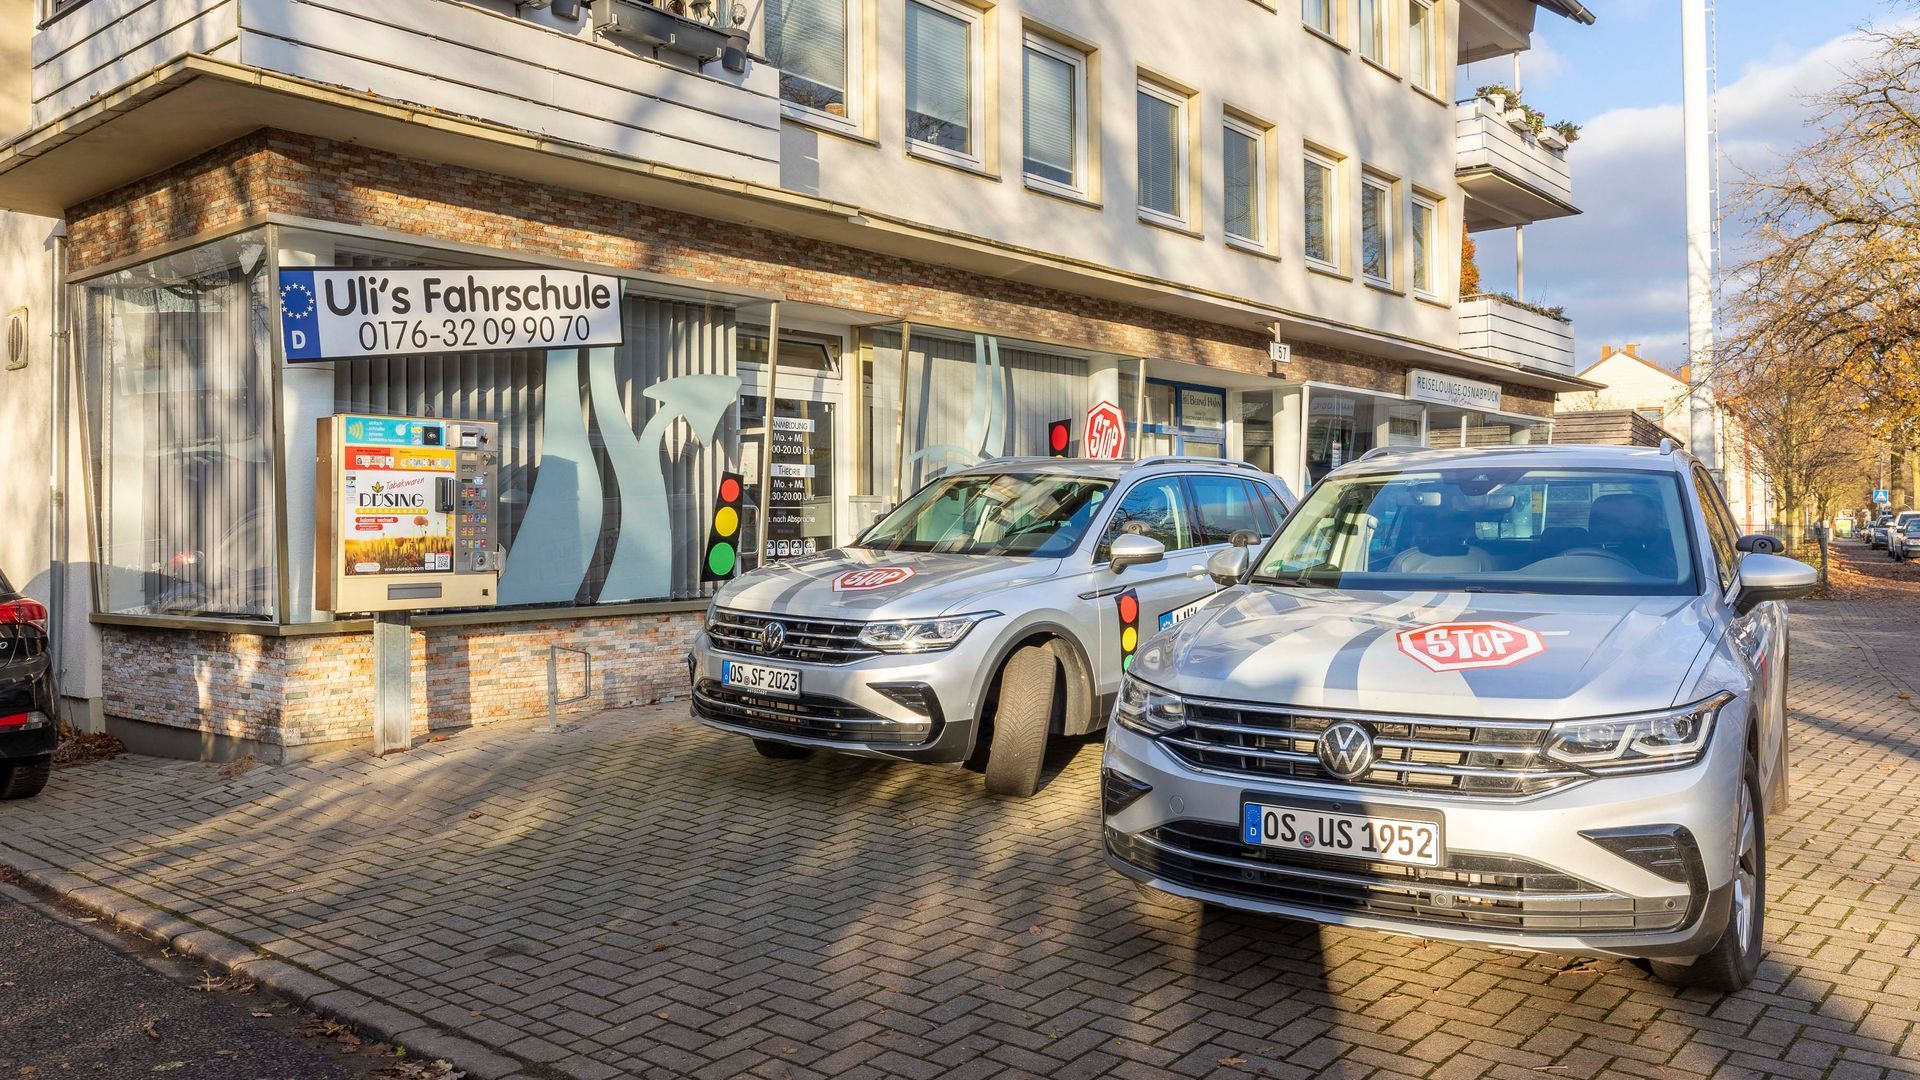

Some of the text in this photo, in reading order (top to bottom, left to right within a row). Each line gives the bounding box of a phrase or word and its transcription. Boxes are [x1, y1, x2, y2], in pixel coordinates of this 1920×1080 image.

[324, 274, 611, 316] Uli's Fahrschule
[292, 330, 306, 350] D
[1278, 346, 1286, 360] 57
[1416, 376, 1461, 396] REISELOUNGE
[1462, 386, 1499, 402] OSNABRÜCK
[774, 432, 786, 442] Mo.
[1090, 414, 1119, 458] STOP
[772, 445, 802, 455] 00-20.00
[386, 478, 425, 490] Tabakwaren
[774, 480, 786, 488] Mo.
[360, 493, 424, 507] DÜSING
[770, 492, 802, 500] .30-20.00
[787, 515, 815, 524] Absprache
[844, 571, 901, 586] STOP
[1424, 629, 1514, 659] STOP
[730, 664, 798, 691] OS SF 2023
[1250, 827, 1257, 836] D
[1264, 811, 1433, 859] OS US 1952
